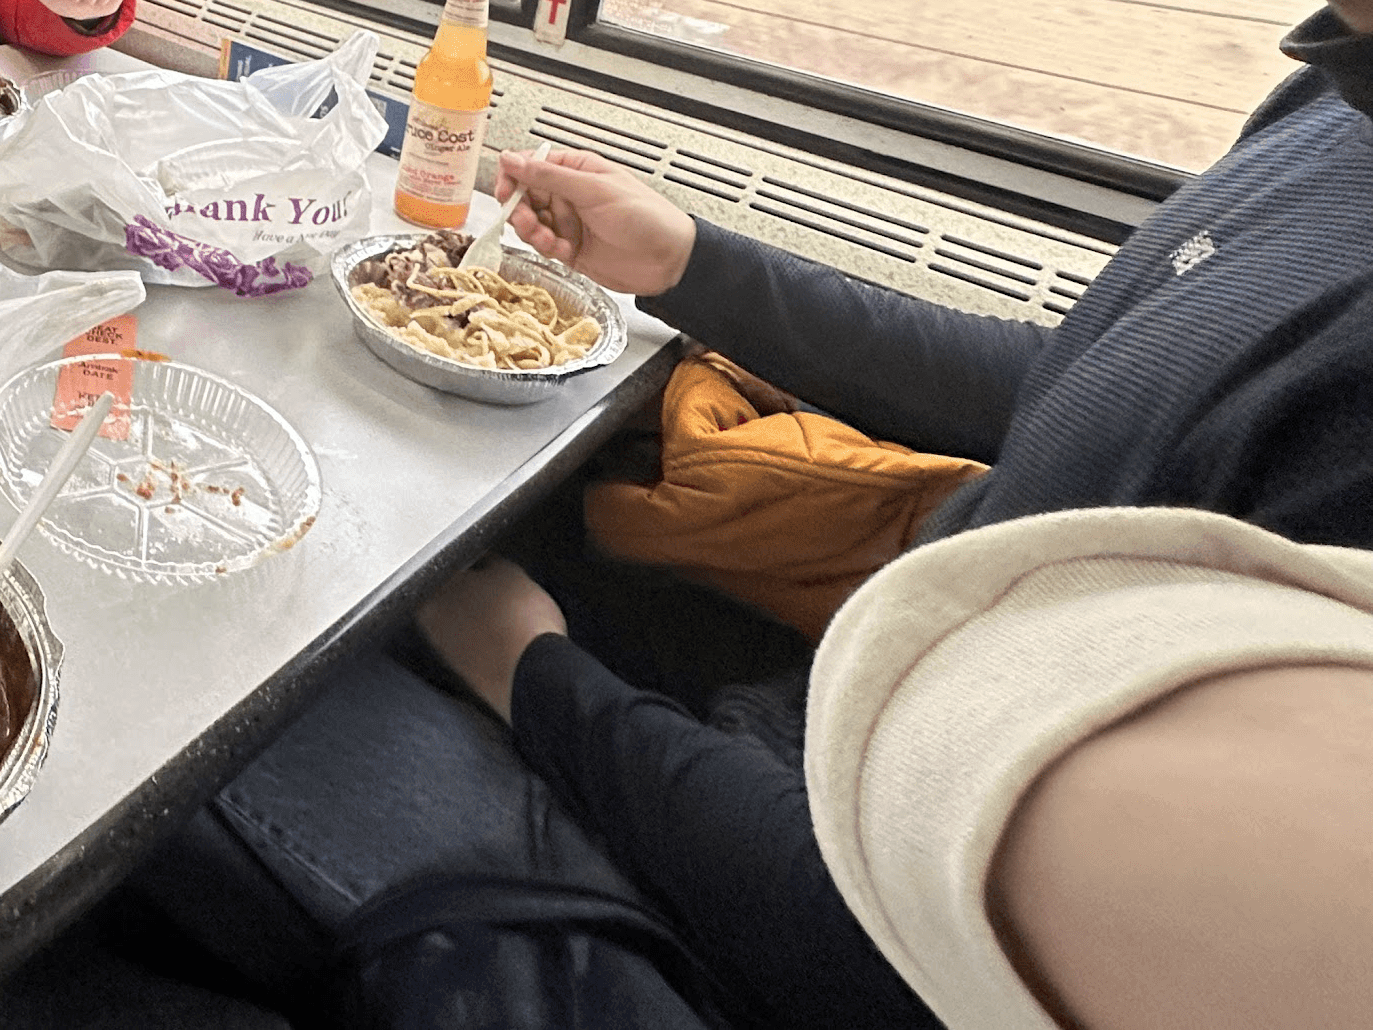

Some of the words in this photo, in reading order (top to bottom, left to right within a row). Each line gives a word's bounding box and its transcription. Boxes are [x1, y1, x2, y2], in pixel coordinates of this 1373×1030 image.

[437, 129, 475, 144] Cost
[456, 144, 471, 152] Ale
[165, 193, 276, 222] ank
[83, 370, 114, 380] DATE
